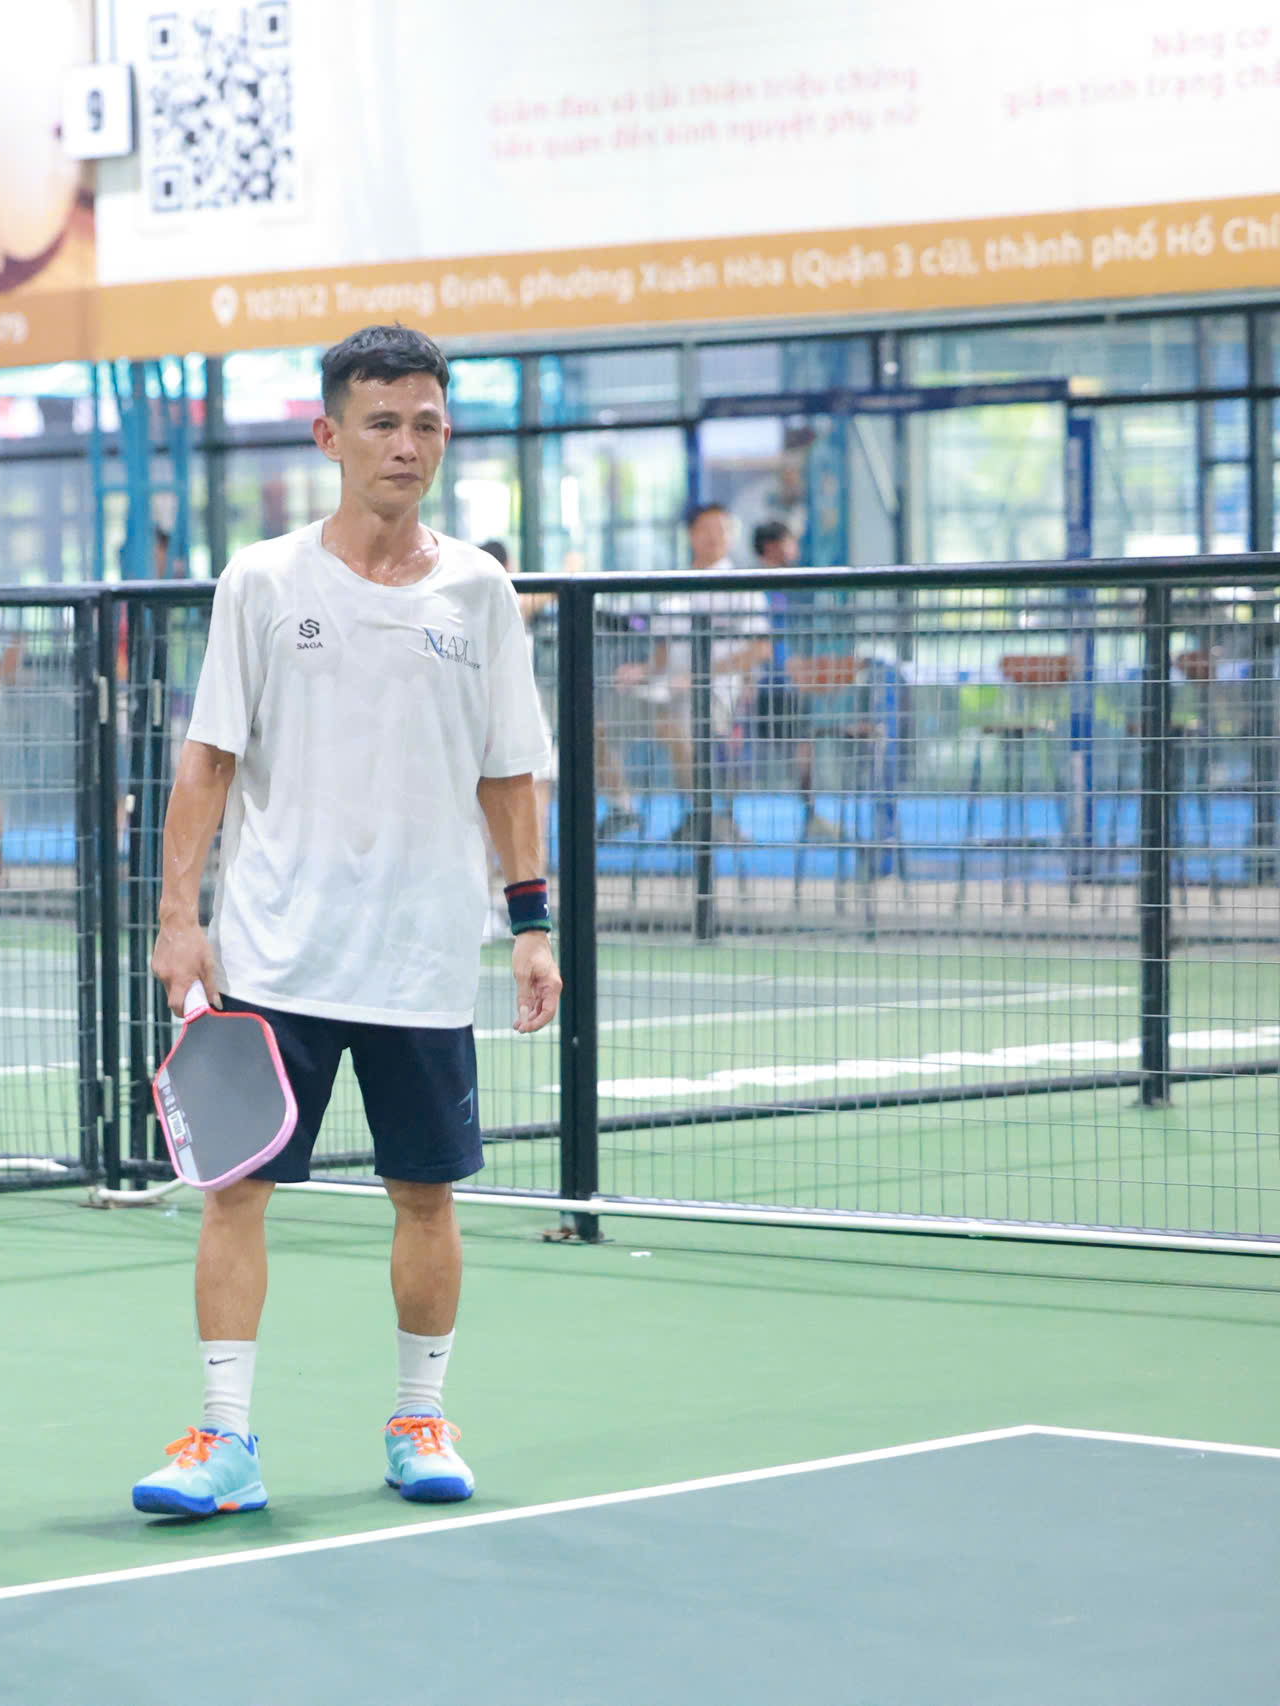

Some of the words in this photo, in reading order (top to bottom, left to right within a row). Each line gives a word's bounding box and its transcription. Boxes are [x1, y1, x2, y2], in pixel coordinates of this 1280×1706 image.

[88, 89, 104, 133] 9
[893, 243, 914, 279] 3
[986, 232, 1082, 271] thành
[1091, 216, 1157, 269] phố
